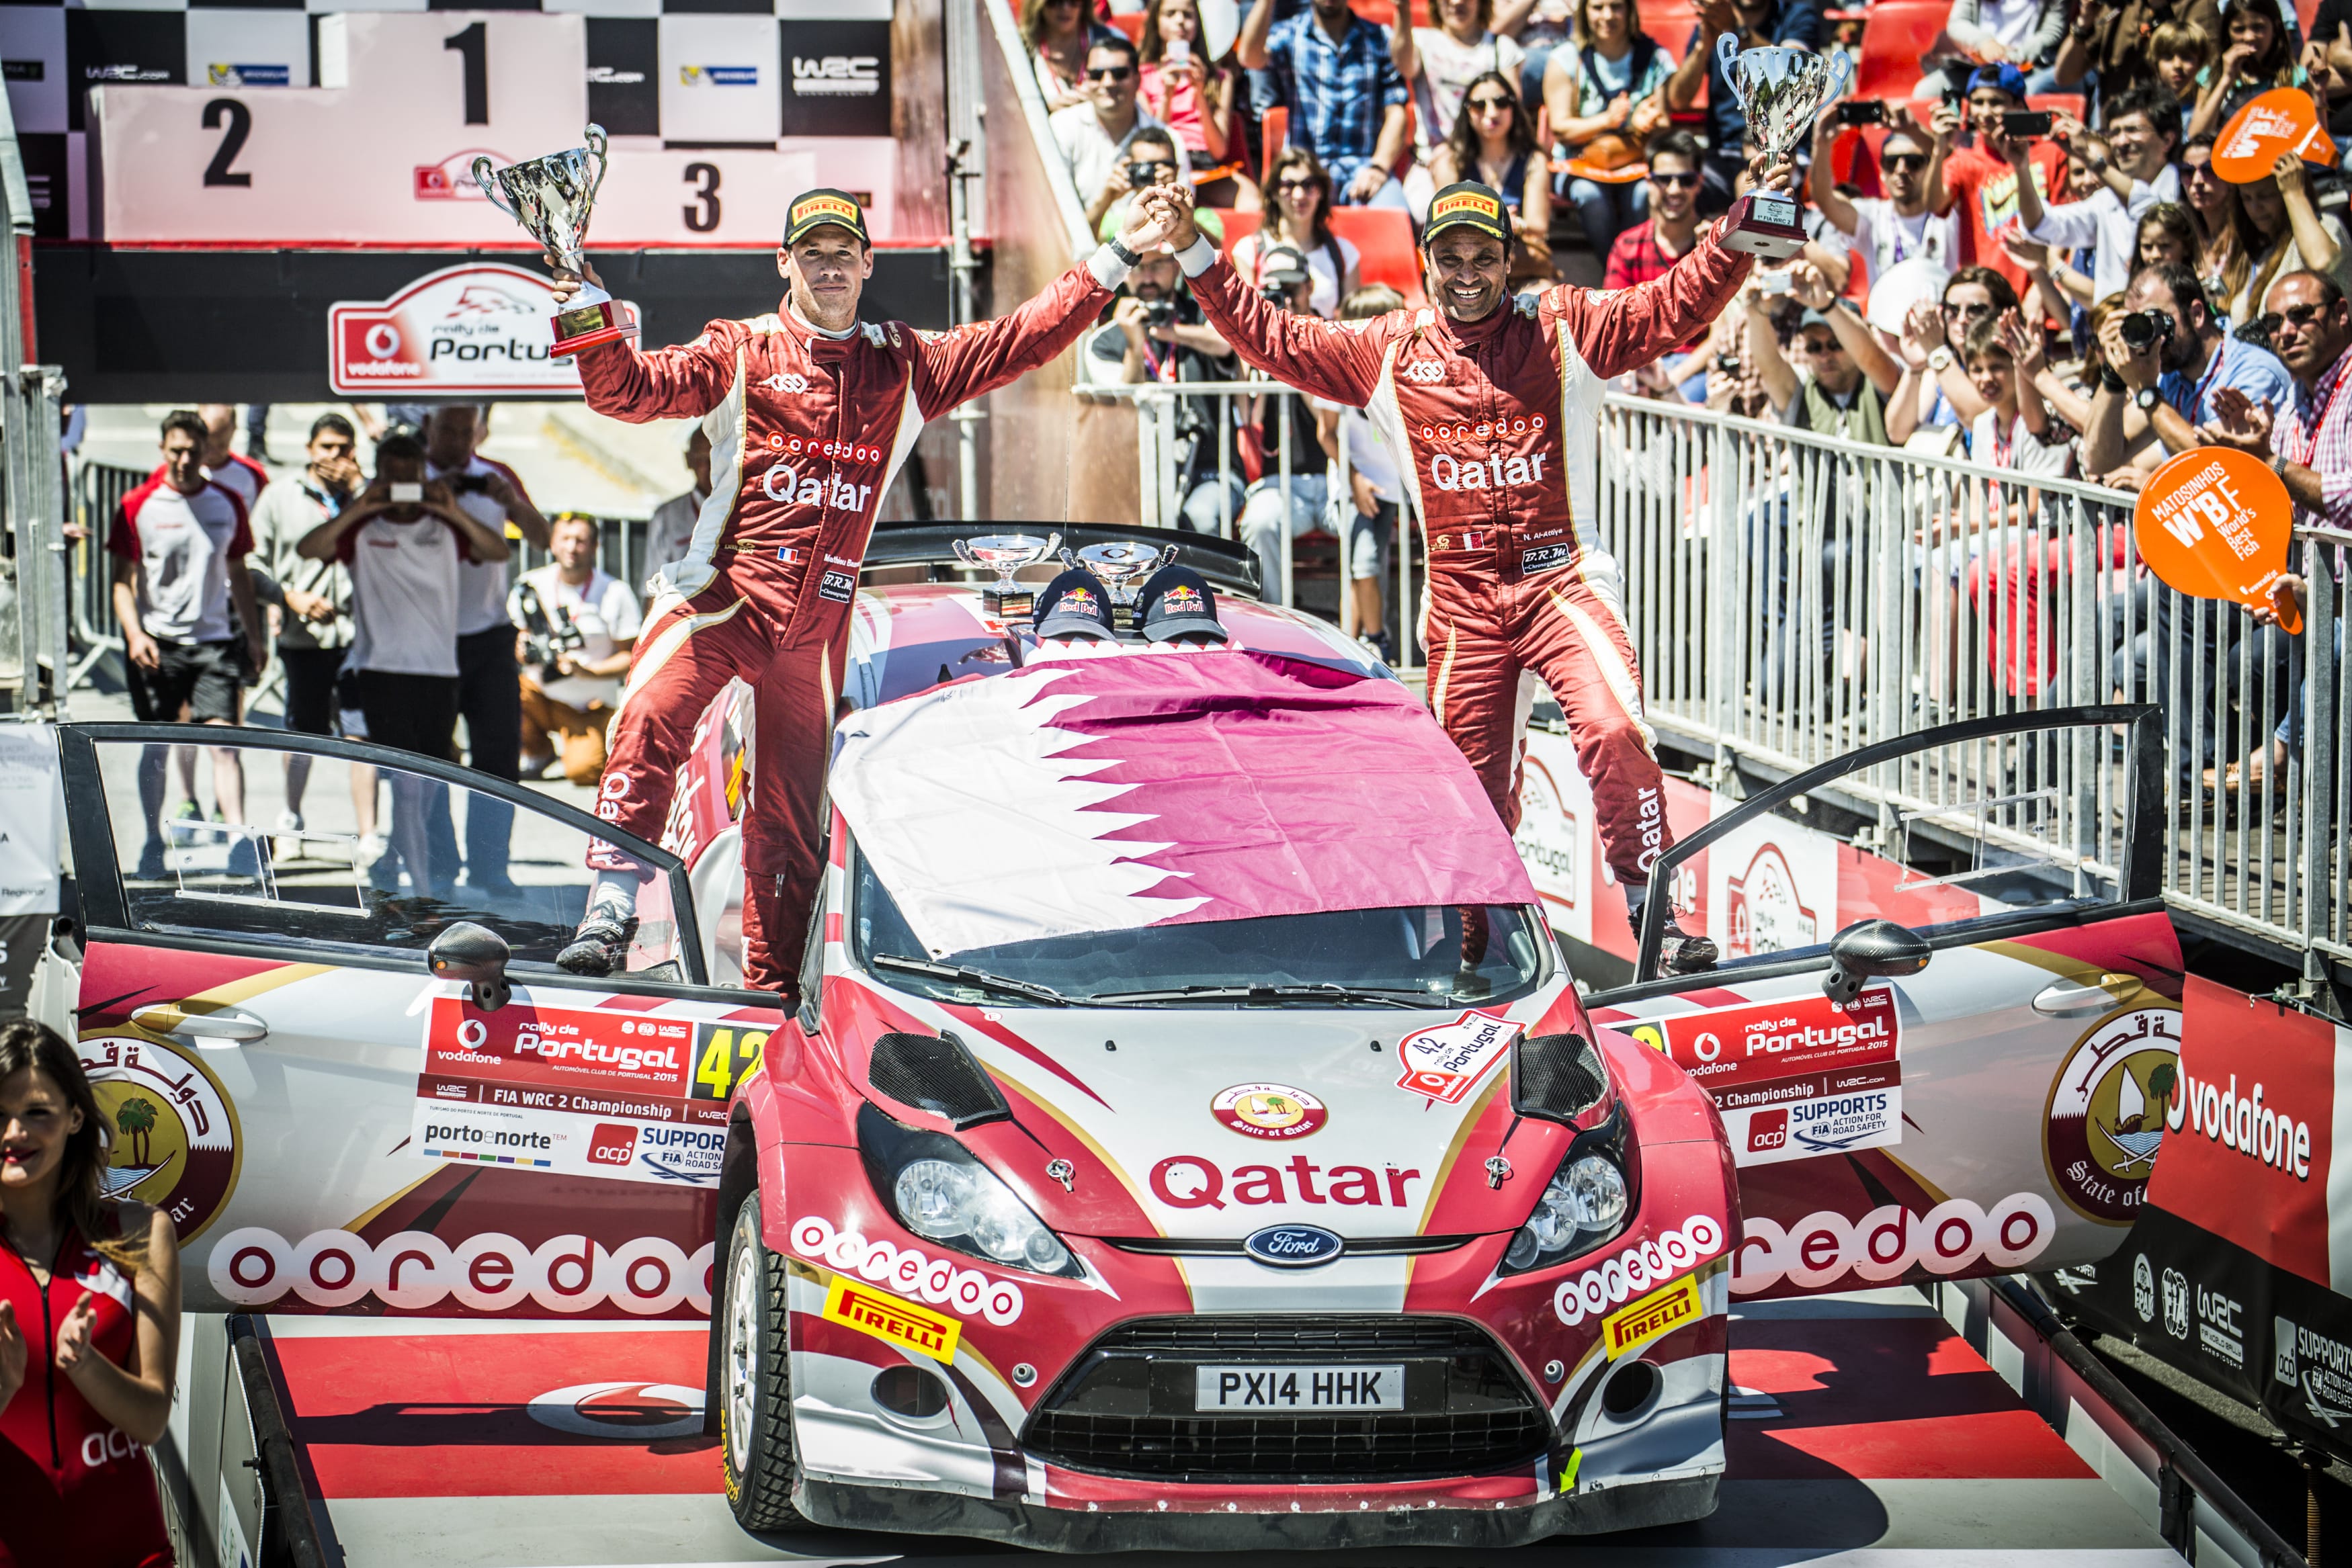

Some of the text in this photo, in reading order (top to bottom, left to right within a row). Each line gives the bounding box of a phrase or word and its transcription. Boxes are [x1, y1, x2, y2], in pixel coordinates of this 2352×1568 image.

[444, 21, 489, 126] 1
[792, 56, 879, 79] WRC
[202, 98, 252, 188] 2
[683, 162, 721, 234] 3
[797, 197, 854, 220] PIRELLI
[1437, 195, 1494, 214] PIRELLI
[432, 324, 500, 337] rally de
[347, 358, 422, 377] vodafone
[1422, 416, 1545, 439] ooredoo
[1431, 451, 1547, 492] Qatar
[763, 464, 872, 513] Qatar
[2150, 460, 2226, 522] MATOSINHOS
[2216, 507, 2257, 538] World's
[1523, 528, 1564, 541] N. Al-Attiya
[2225, 525, 2254, 551] Best
[823, 552, 847, 567] Mathieu
[2234, 539, 2261, 562] Fish
[1059, 601, 1099, 616] Red Bull
[1165, 601, 1205, 613] Red Bull
[1636, 787, 1663, 873] Qatar
[1862, 994, 1887, 1004] WRC
[519, 1021, 556, 1036] rally
[558, 1024, 579, 1036] de
[1745, 1017, 1798, 1033] rally de
[1746, 1016, 1890, 1057] Portugal
[437, 1050, 502, 1065] vodafone
[514, 1032, 680, 1070] Portugal
[1412, 1037, 1447, 1055] 42
[1433, 1047, 1455, 1066] rally de
[1443, 1022, 1502, 1073] Portugal
[1781, 1053, 1814, 1063] AUTOMÓVEL
[1837, 1045, 1866, 1055] PORTUGAL
[1867, 1040, 1889, 1051] 2015
[552, 1064, 591, 1075] AUTOMÓVEL
[617, 1071, 651, 1080] PORTUGAL
[653, 1072, 678, 1082] 2015
[696, 1028, 770, 1098] 42
[1440, 1076, 1464, 1097] vodafone
[1714, 1076, 1886, 1108] 2 Championship WRC.com
[436, 1084, 468, 1094] WRC
[494, 1088, 518, 1104] FIA
[521, 1091, 555, 1107] WRC
[558, 1095, 568, 1108] 2
[572, 1096, 673, 1121] Championship
[1792, 1093, 1887, 1123] SUPPORTS
[1230, 1120, 1314, 1137] State of Qatar
[1833, 1112, 1882, 1127] ACTION FOR
[1833, 1119, 1887, 1135] ROAD SAFETY
[2188, 1074, 2310, 1180] vodafone
[1753, 1130, 1785, 1147] acp
[595, 1145, 632, 1163] acp
[685, 1160, 711, 1170] ROAD
[686, 1151, 721, 1161] ACTION
[1149, 1155, 1421, 1211] Qatar
[2066, 1160, 2142, 1207] State of
[1267, 1231, 1320, 1256] Ford
[800, 1225, 1014, 1316] ooredoo
[1560, 1223, 1714, 1316] ooredoo
[837, 1289, 948, 1353] PIRELLI
[1612, 1287, 1693, 1349] PIRELLI
[2197, 1283, 2243, 1339] WRC
[2278, 1354, 2296, 1381] acp
[1218, 1368, 1382, 1406] PX14 HHK
[2323, 1369, 2342, 1390] ACTION
[2322, 1384, 2337, 1403] ROAD
[720, 1408, 741, 1502] SCORPION
